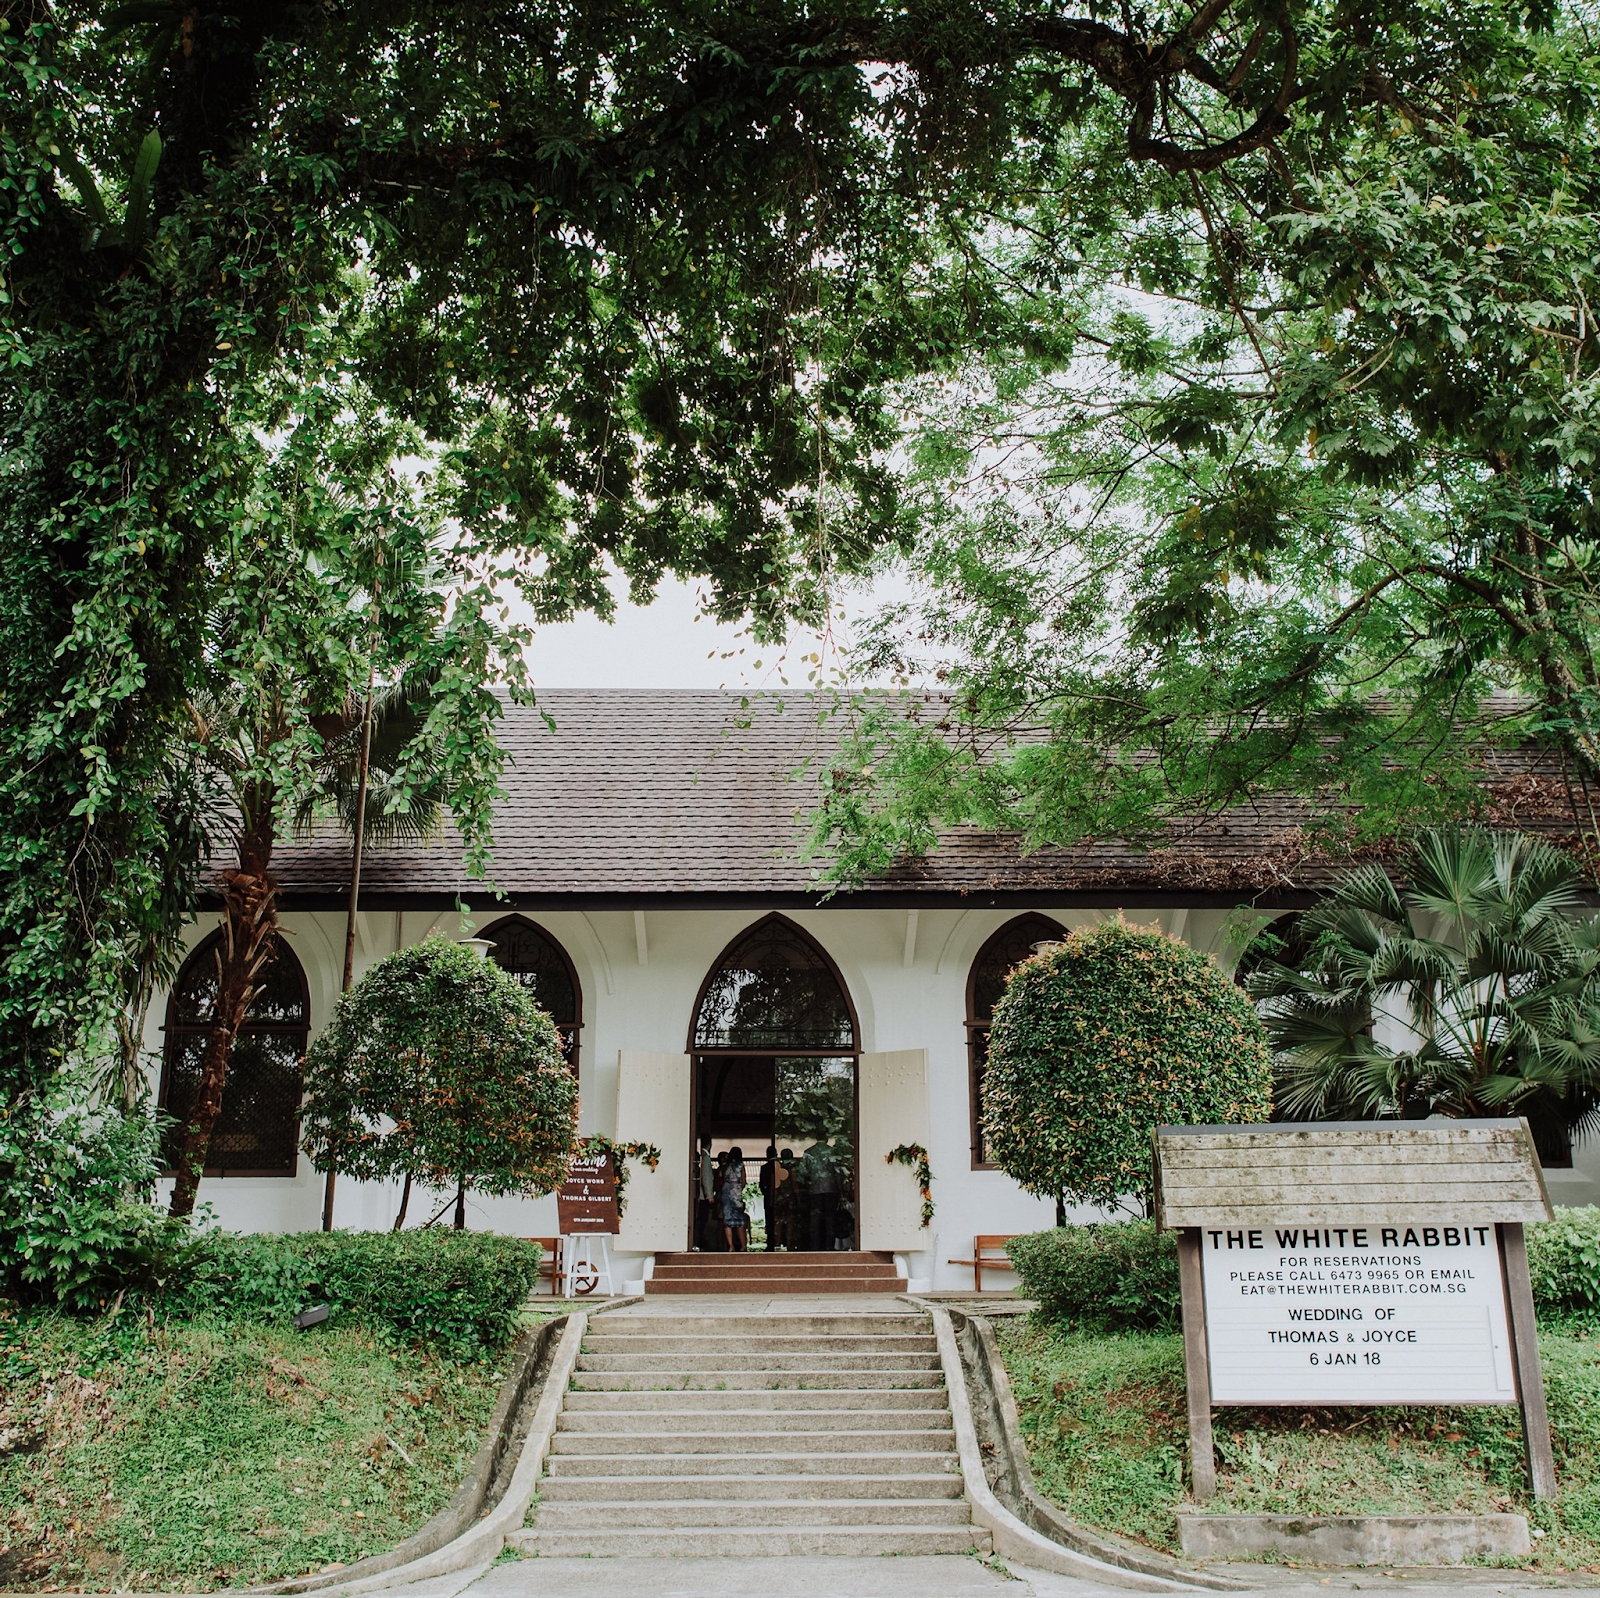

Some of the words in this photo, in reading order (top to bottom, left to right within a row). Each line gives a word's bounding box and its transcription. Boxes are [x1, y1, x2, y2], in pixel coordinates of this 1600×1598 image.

[583, 1185, 590, 1195] &
[1207, 1229, 1264, 1250] THE
[1274, 1228, 1369, 1249] WHITE
[1381, 1226, 1490, 1248] RABBIT
[1279, 1257, 1308, 1267] FOR
[1313, 1255, 1422, 1267] RESERVATIONS
[1230, 1271, 1284, 1282] PLEASE
[1289, 1270, 1325, 1281] CALL
[1330, 1270, 1362, 1280] 6473
[1367, 1270, 1399, 1280] 9965
[1404, 1269, 1425, 1280] OR
[1430, 1269, 1475, 1280] EMAIL
[1241, 1283, 1466, 1295] EAT@THEWHITERABBIT.COM.SG
[1288, 1308, 1363, 1321] WEDDING
[1374, 1307, 1396, 1321] OF
[1267, 1330, 1339, 1343] THOMAS
[1346, 1332, 1355, 1343] &
[1362, 1330, 1417, 1343] JOYCE
[1309, 1352, 1319, 1366] 6
[1324, 1352, 1357, 1366] JAN
[1363, 1351, 1381, 1366] 18
